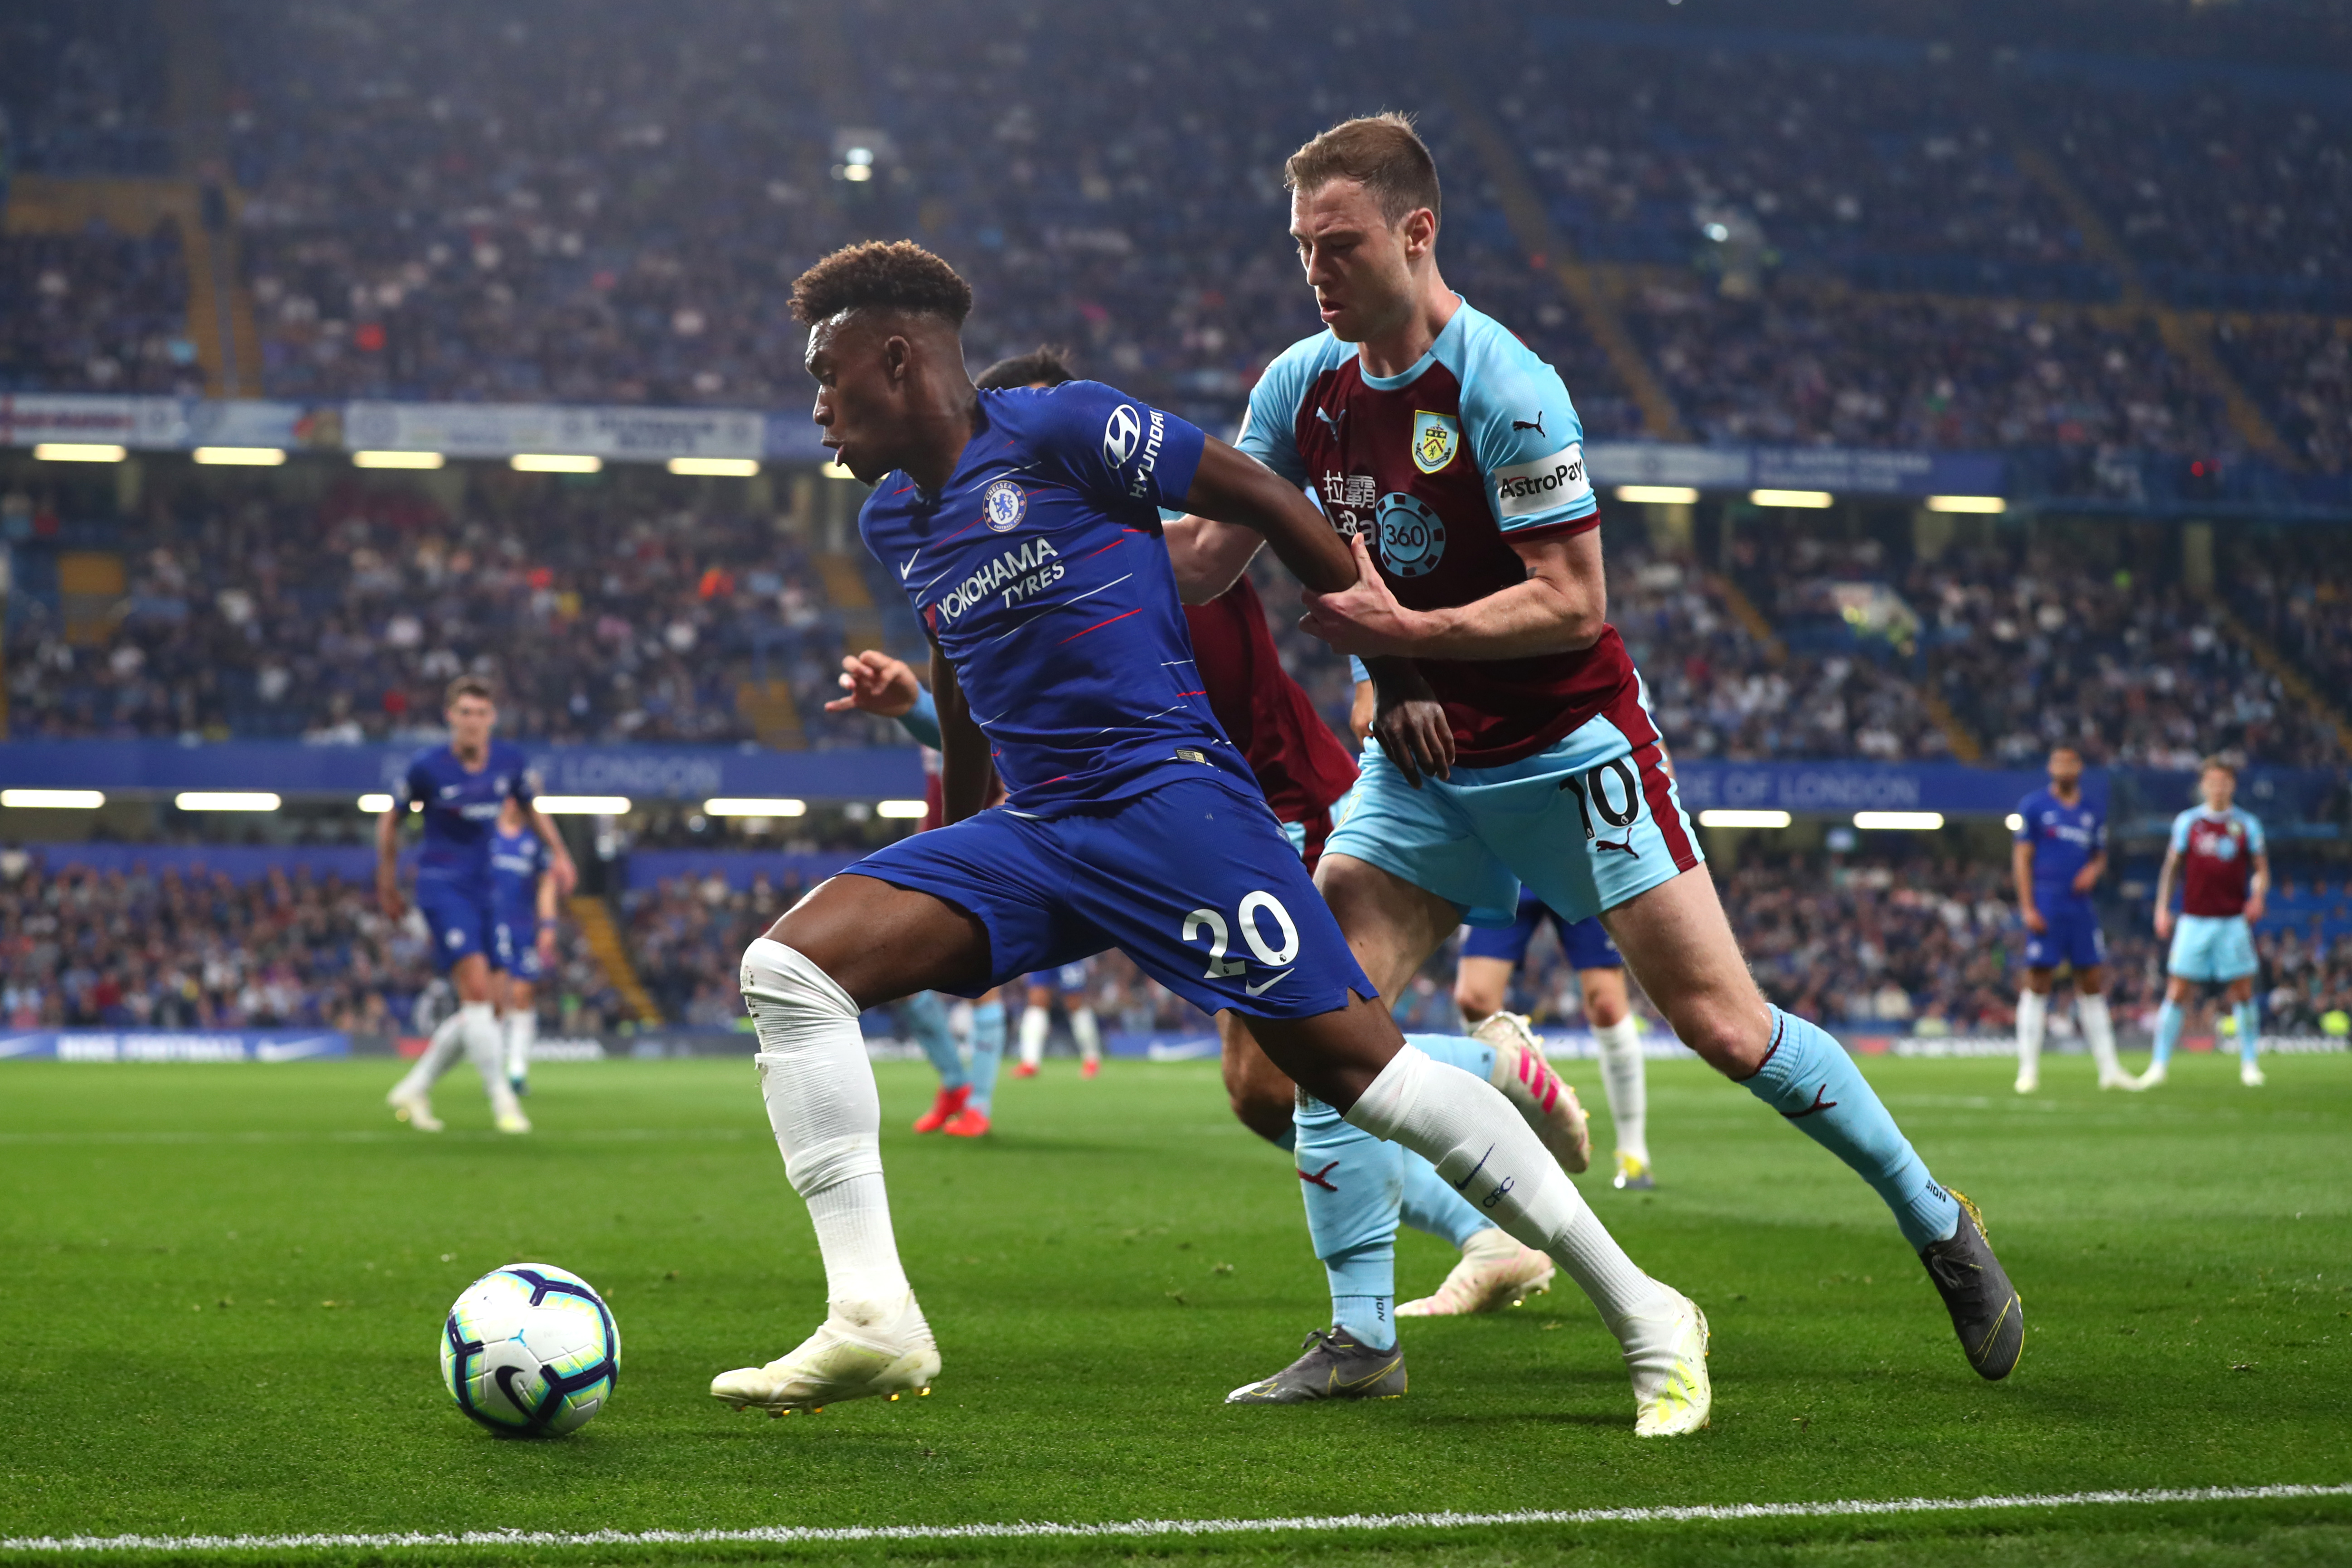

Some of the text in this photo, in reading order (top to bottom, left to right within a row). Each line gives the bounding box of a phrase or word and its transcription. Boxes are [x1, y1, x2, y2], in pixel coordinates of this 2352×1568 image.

[1129, 410, 1165, 498] HYUNDAI
[986, 482, 1012, 501] CHELSEA
[1323, 469, 1376, 509] 拉霸
[1500, 458, 1582, 498] AstroPay
[1013, 513, 1022, 523] CLUB
[1385, 523, 1425, 547] 360
[936, 536, 1059, 624] YOKOHAMA
[1001, 559, 1065, 609] TYRES
[1559, 757, 1639, 841] 10
[1182, 890, 1300, 979] 20
